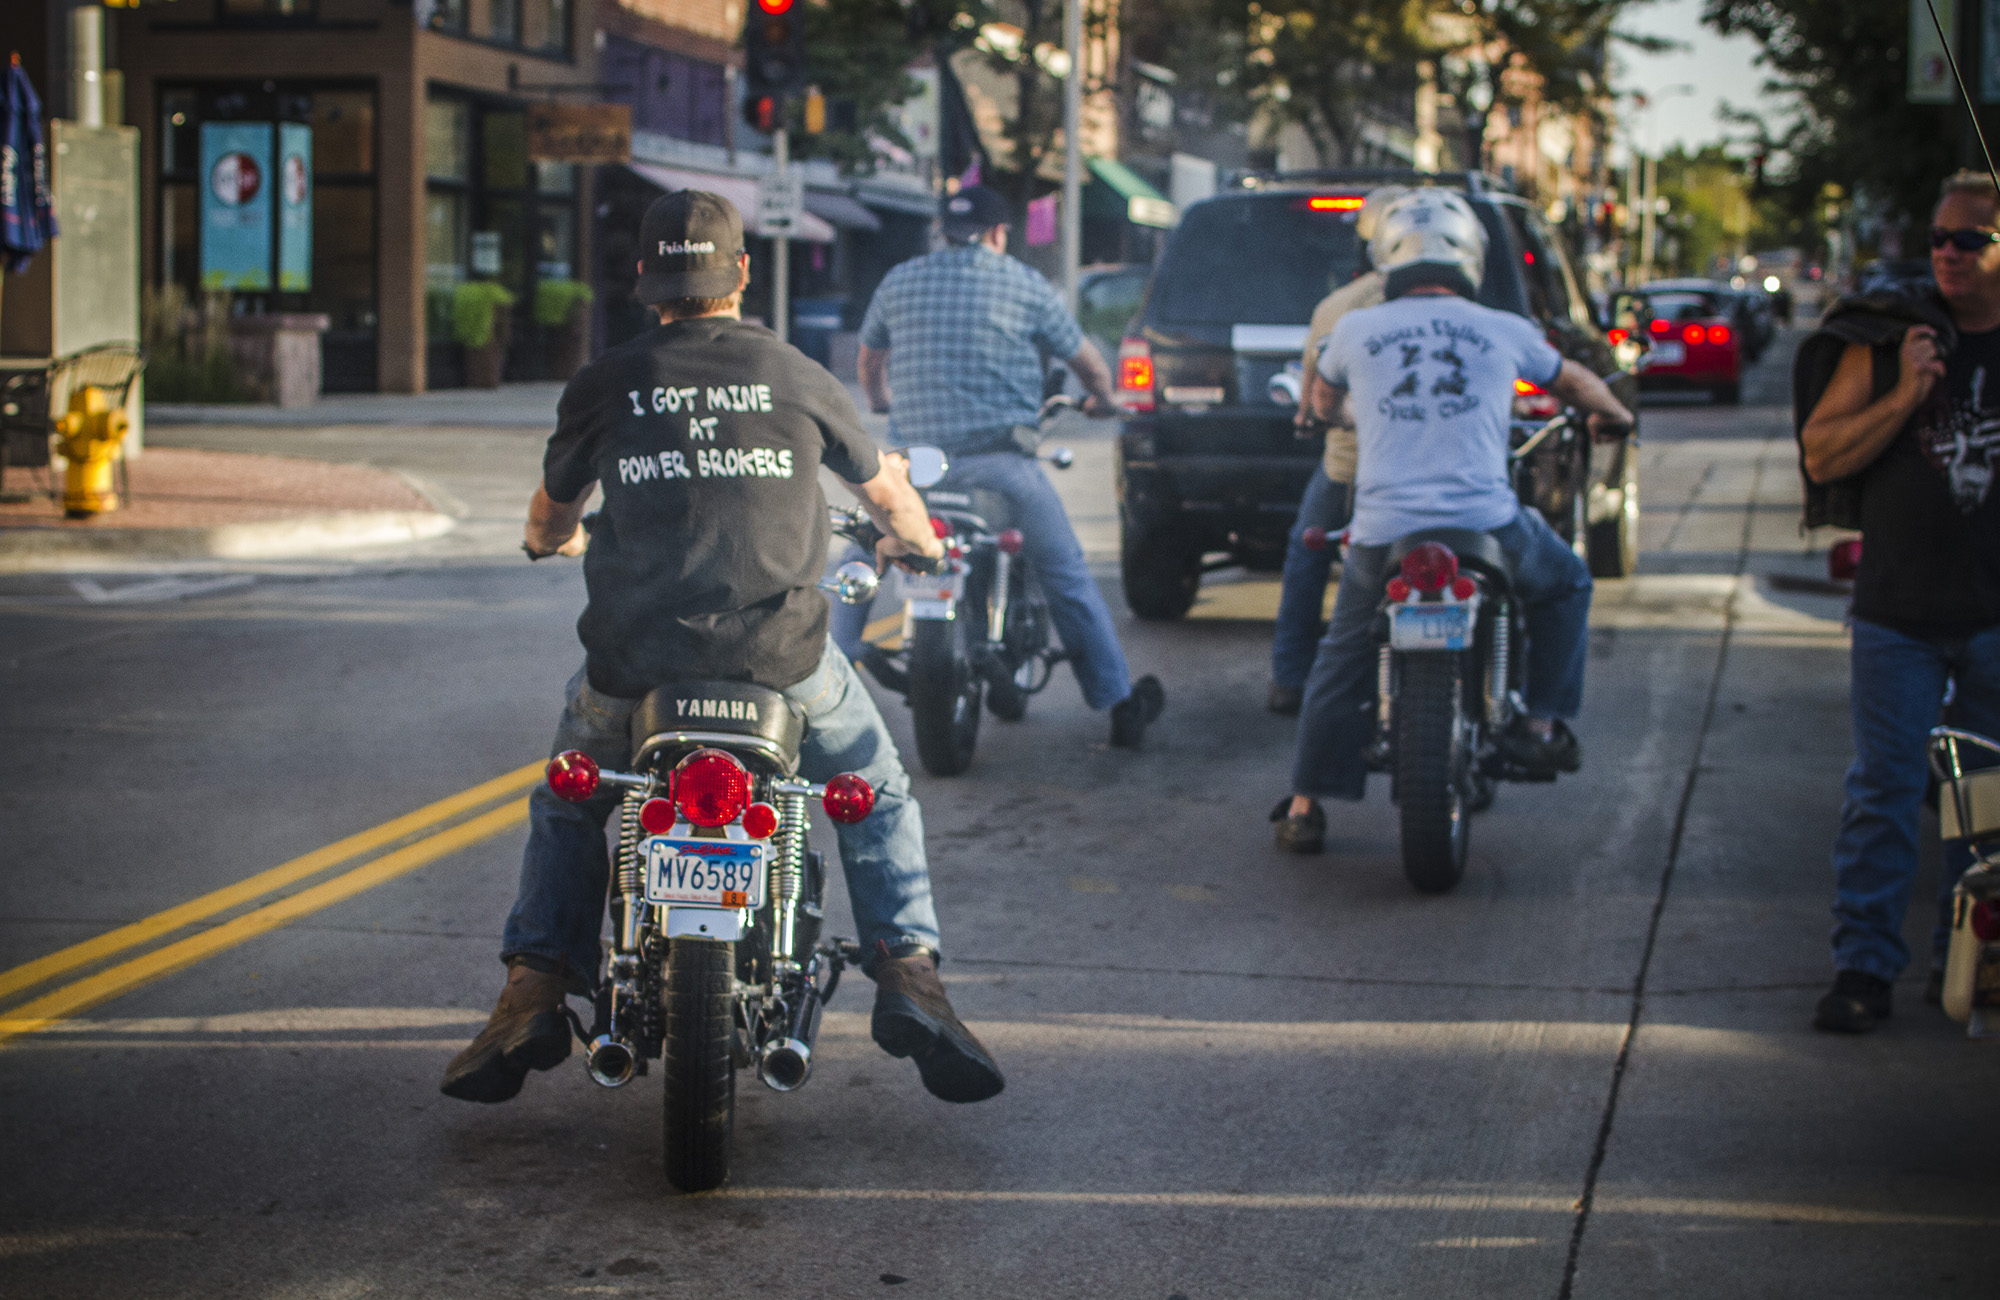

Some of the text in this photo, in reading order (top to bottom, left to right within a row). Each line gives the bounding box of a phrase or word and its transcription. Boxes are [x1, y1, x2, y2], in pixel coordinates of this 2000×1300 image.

[628, 384, 773, 417] I GOT MINE
[689, 416, 719, 441] AT
[618, 447, 794, 484] POWER BROKERS
[676, 698, 758, 722] YAMAHA
[657, 857, 753, 892] MV6589
